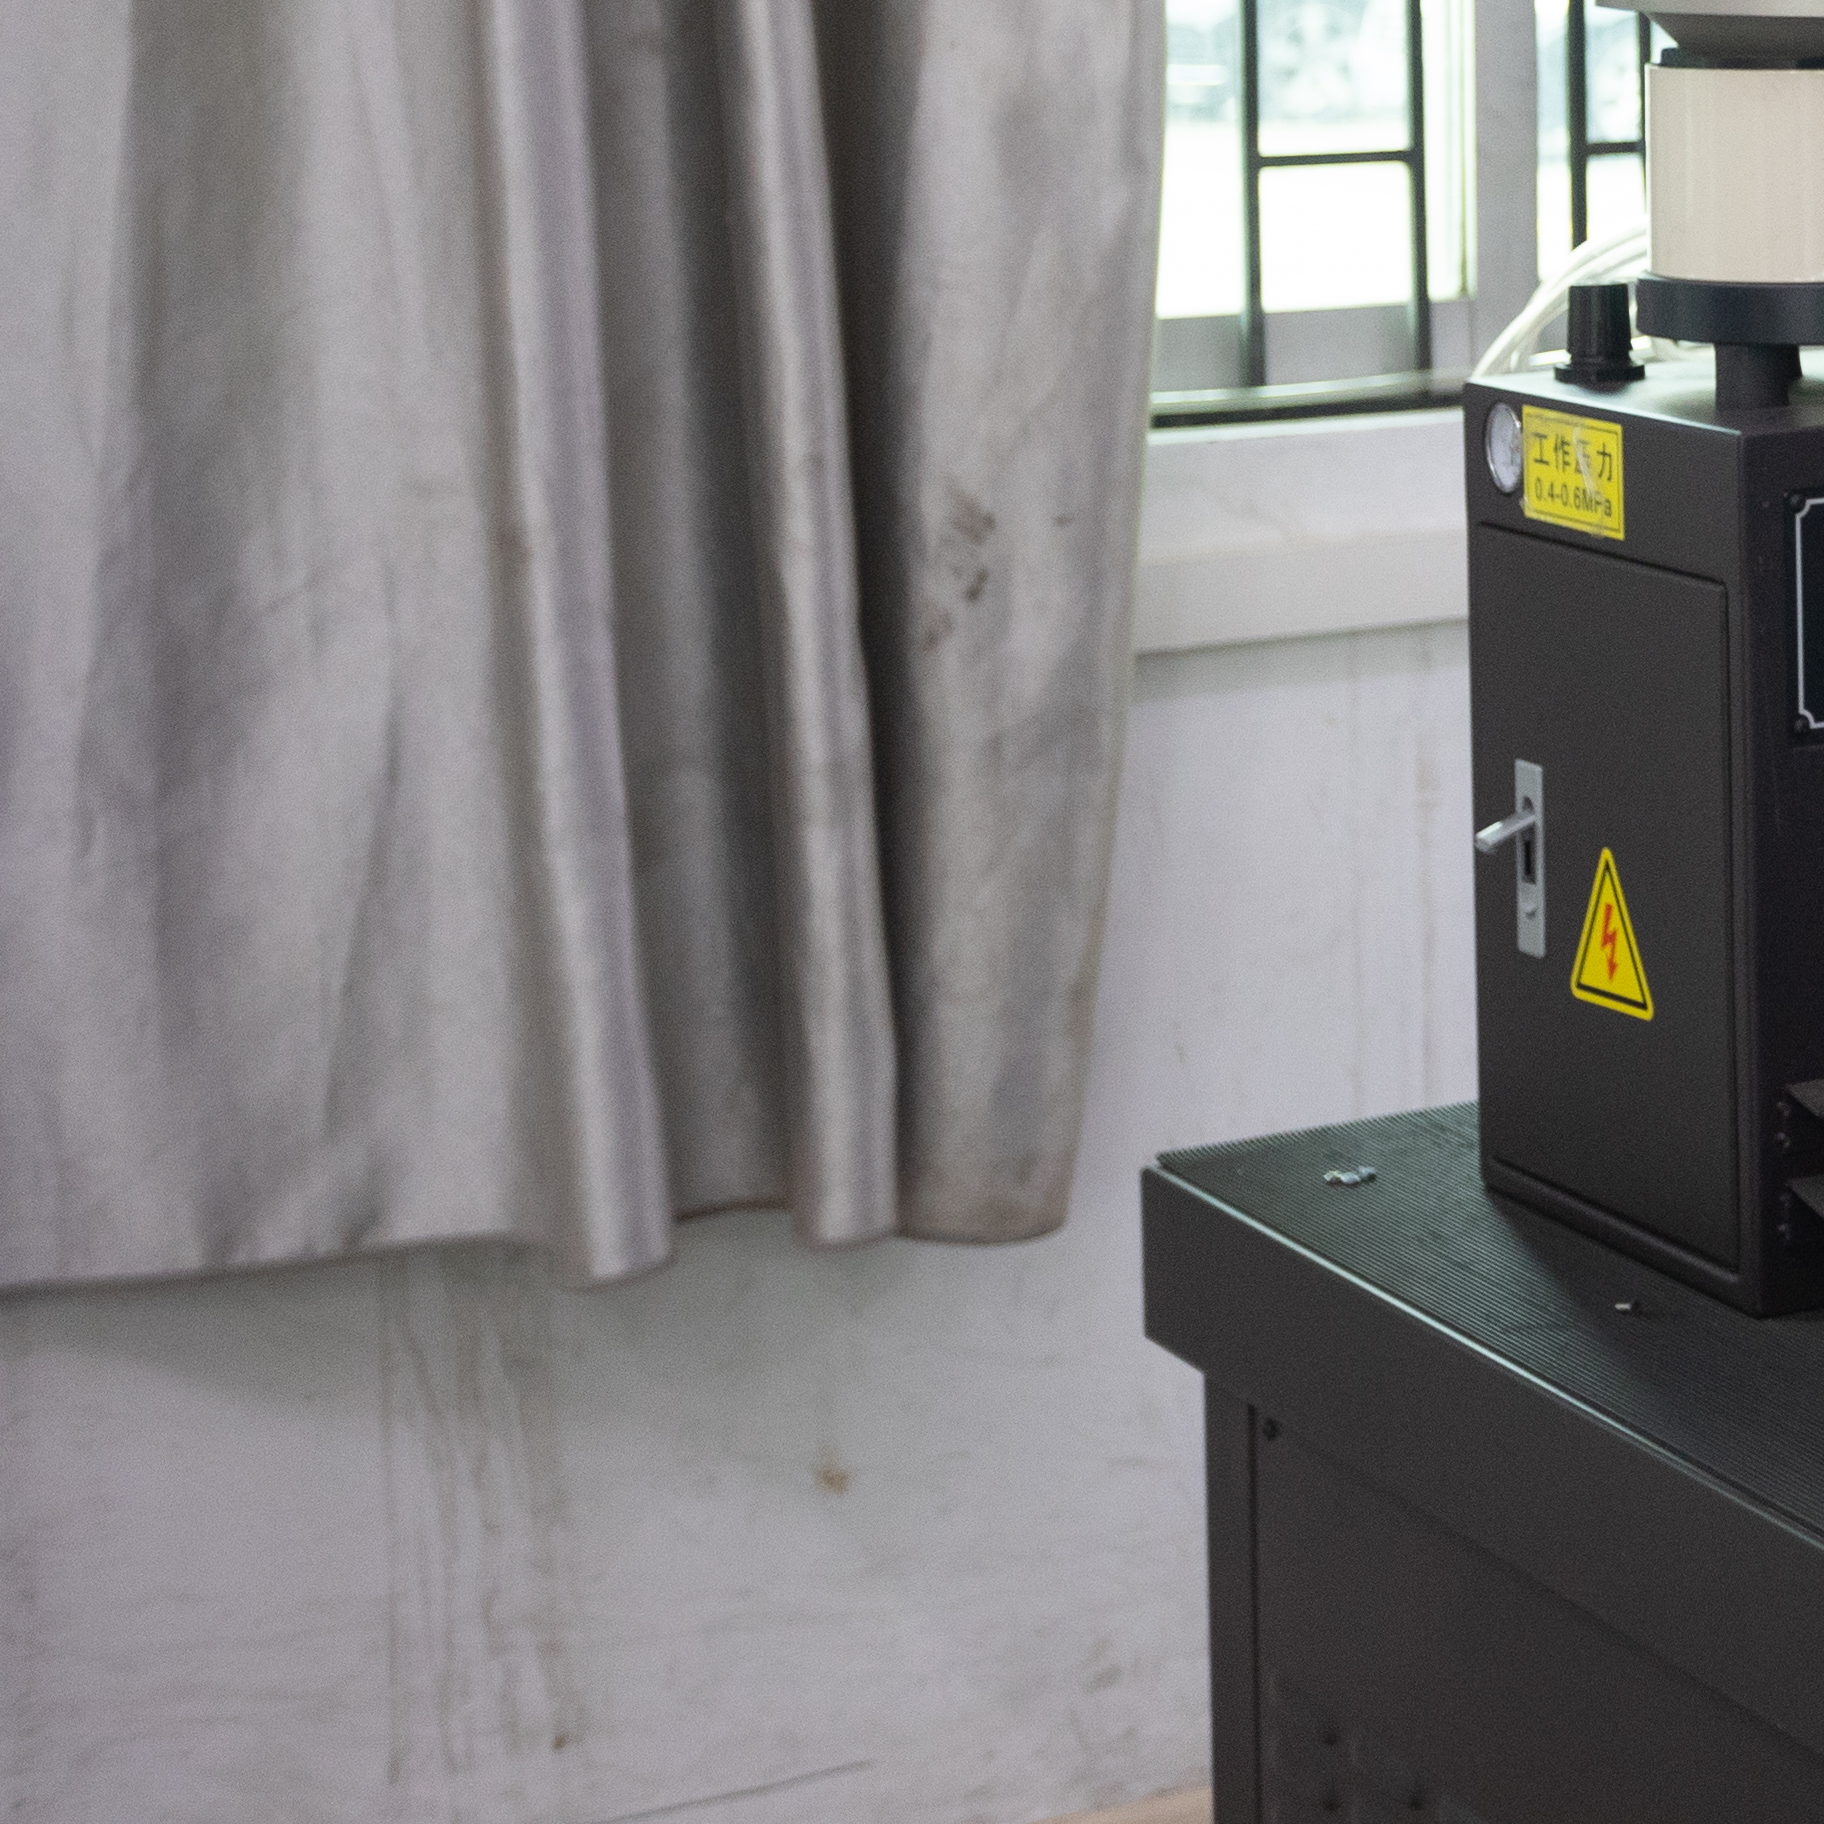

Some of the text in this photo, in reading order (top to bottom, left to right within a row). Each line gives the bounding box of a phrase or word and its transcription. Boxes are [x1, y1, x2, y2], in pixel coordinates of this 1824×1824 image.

[1532, 431, 1614, 482] 工作压力
[1534, 476, 1613, 518] 0.4-0.6MPa
